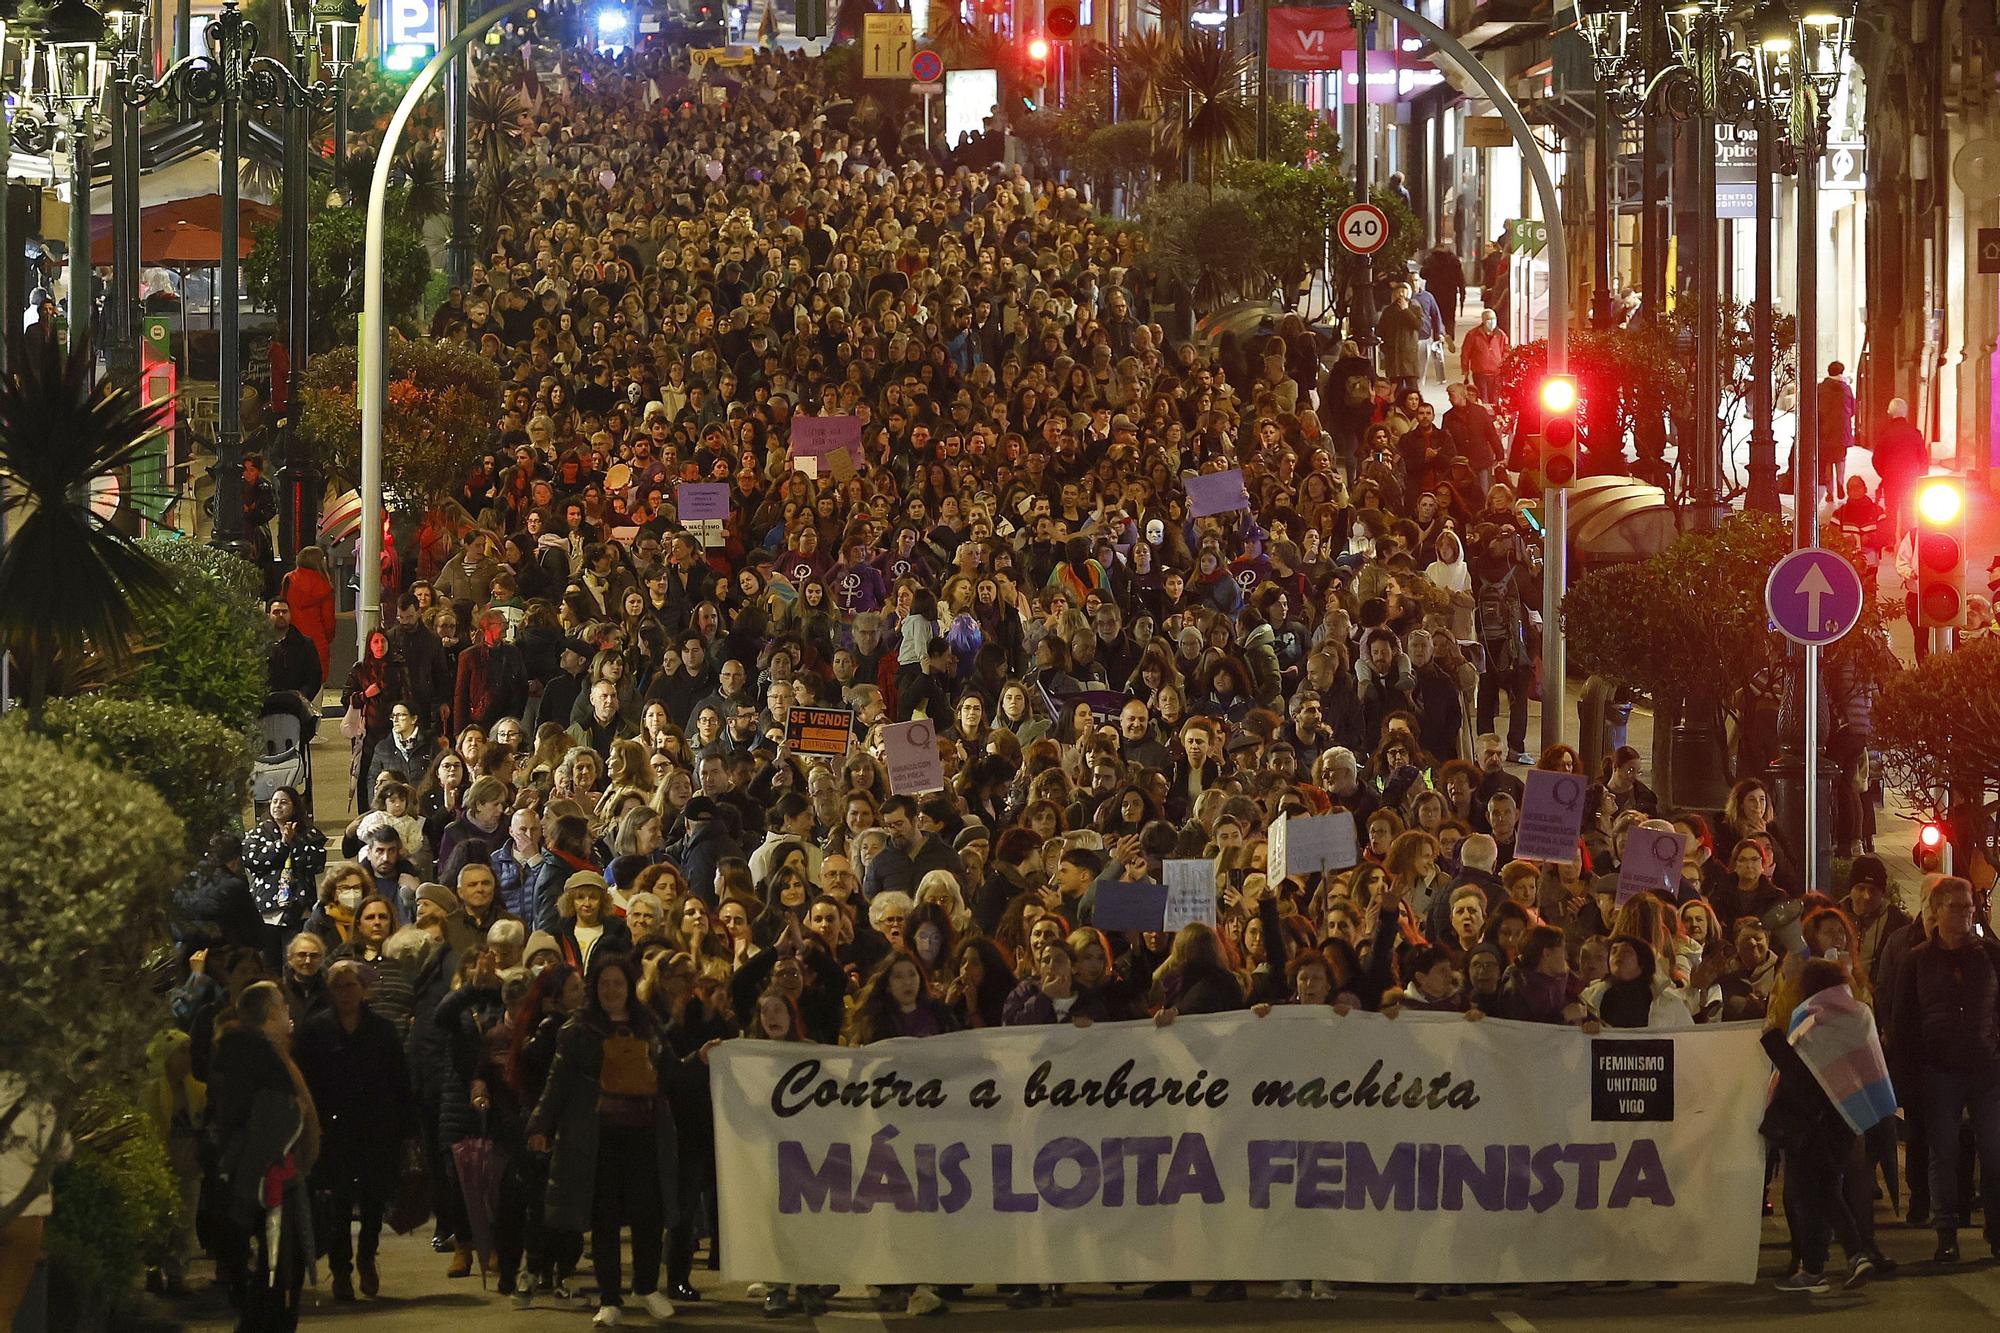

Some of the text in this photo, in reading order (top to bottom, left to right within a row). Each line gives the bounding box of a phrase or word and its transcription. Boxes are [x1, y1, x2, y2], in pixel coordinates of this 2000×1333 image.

[1715, 124, 1758, 141] Uloa
[1716, 193, 1753, 201] CENTRO
[1716, 200, 1754, 208] UDITIVO
[1348, 220, 1377, 237] 40
[791, 711, 850, 727] SE VENDE
[1599, 1056, 1665, 1071] FEMINISMO
[771, 1059, 1481, 1117] Contra a barbarie machista
[1606, 1077, 1657, 1092] UNITARIO
[1619, 1099, 1645, 1114] VIGO
[777, 1124, 1676, 1214] MÁIS LOITA FEMINISTA
